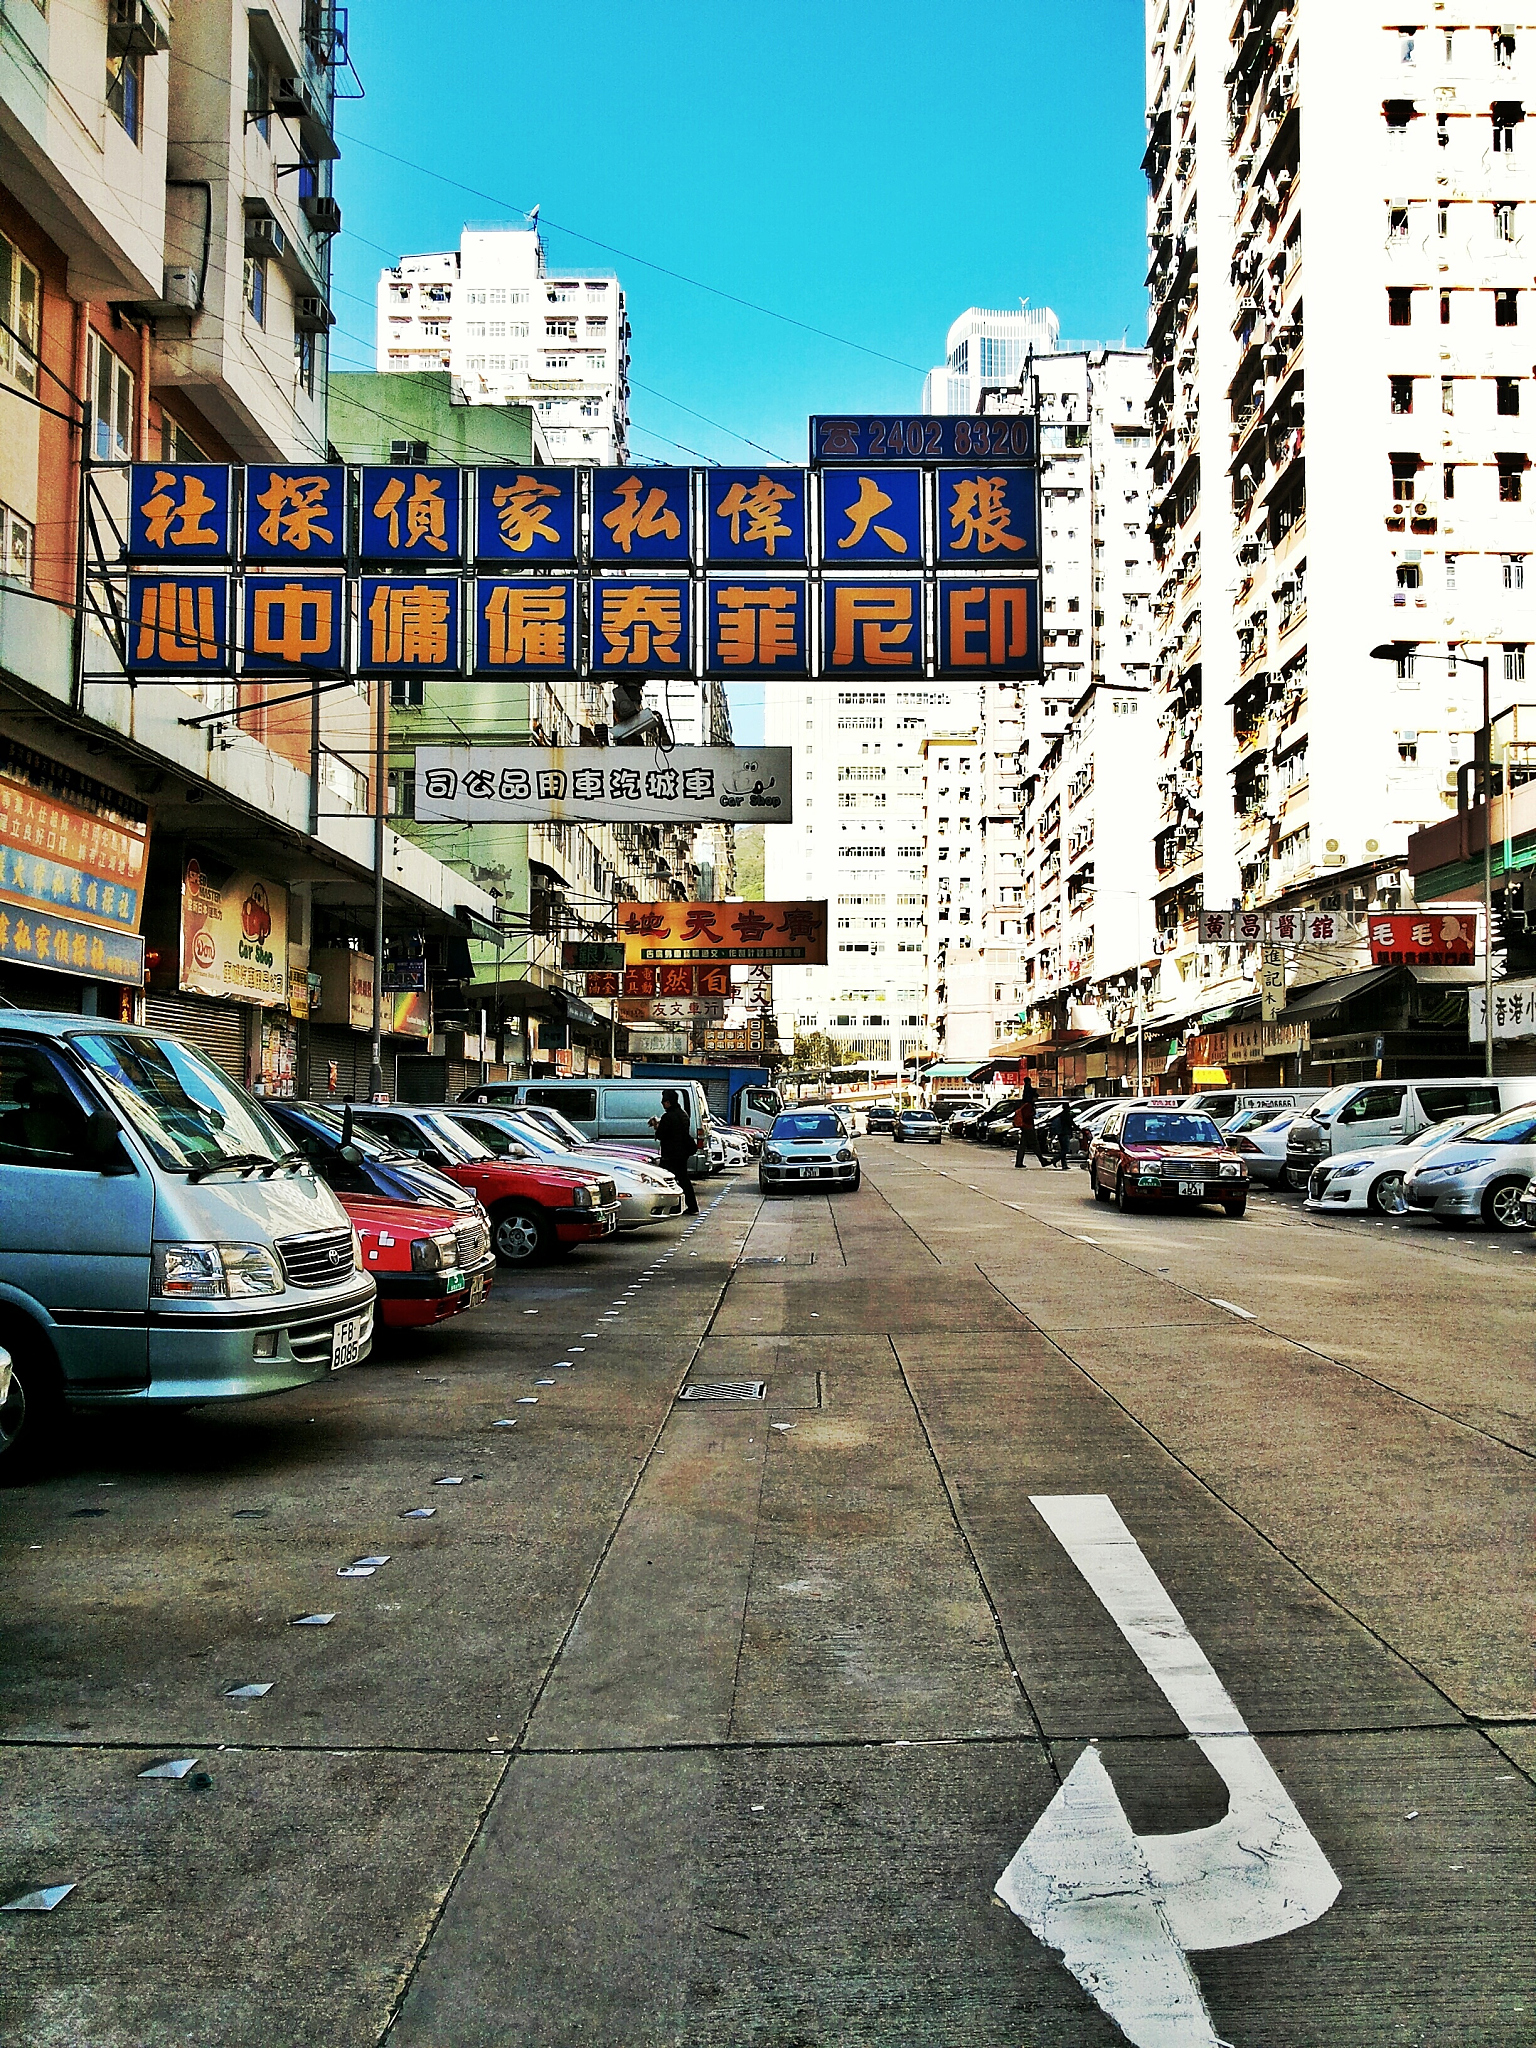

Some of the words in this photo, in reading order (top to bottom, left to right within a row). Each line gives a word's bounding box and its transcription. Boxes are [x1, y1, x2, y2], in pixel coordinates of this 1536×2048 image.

[869, 421, 943, 455] 2402
[954, 421, 1028, 455] 8320
[720, 795, 745, 808] Car
[1372, 922, 1435, 946] 毛毛
[238, 939, 254, 960] Car
[255, 944, 274, 969] Shop
[334, 1340, 358, 1367] 8085
